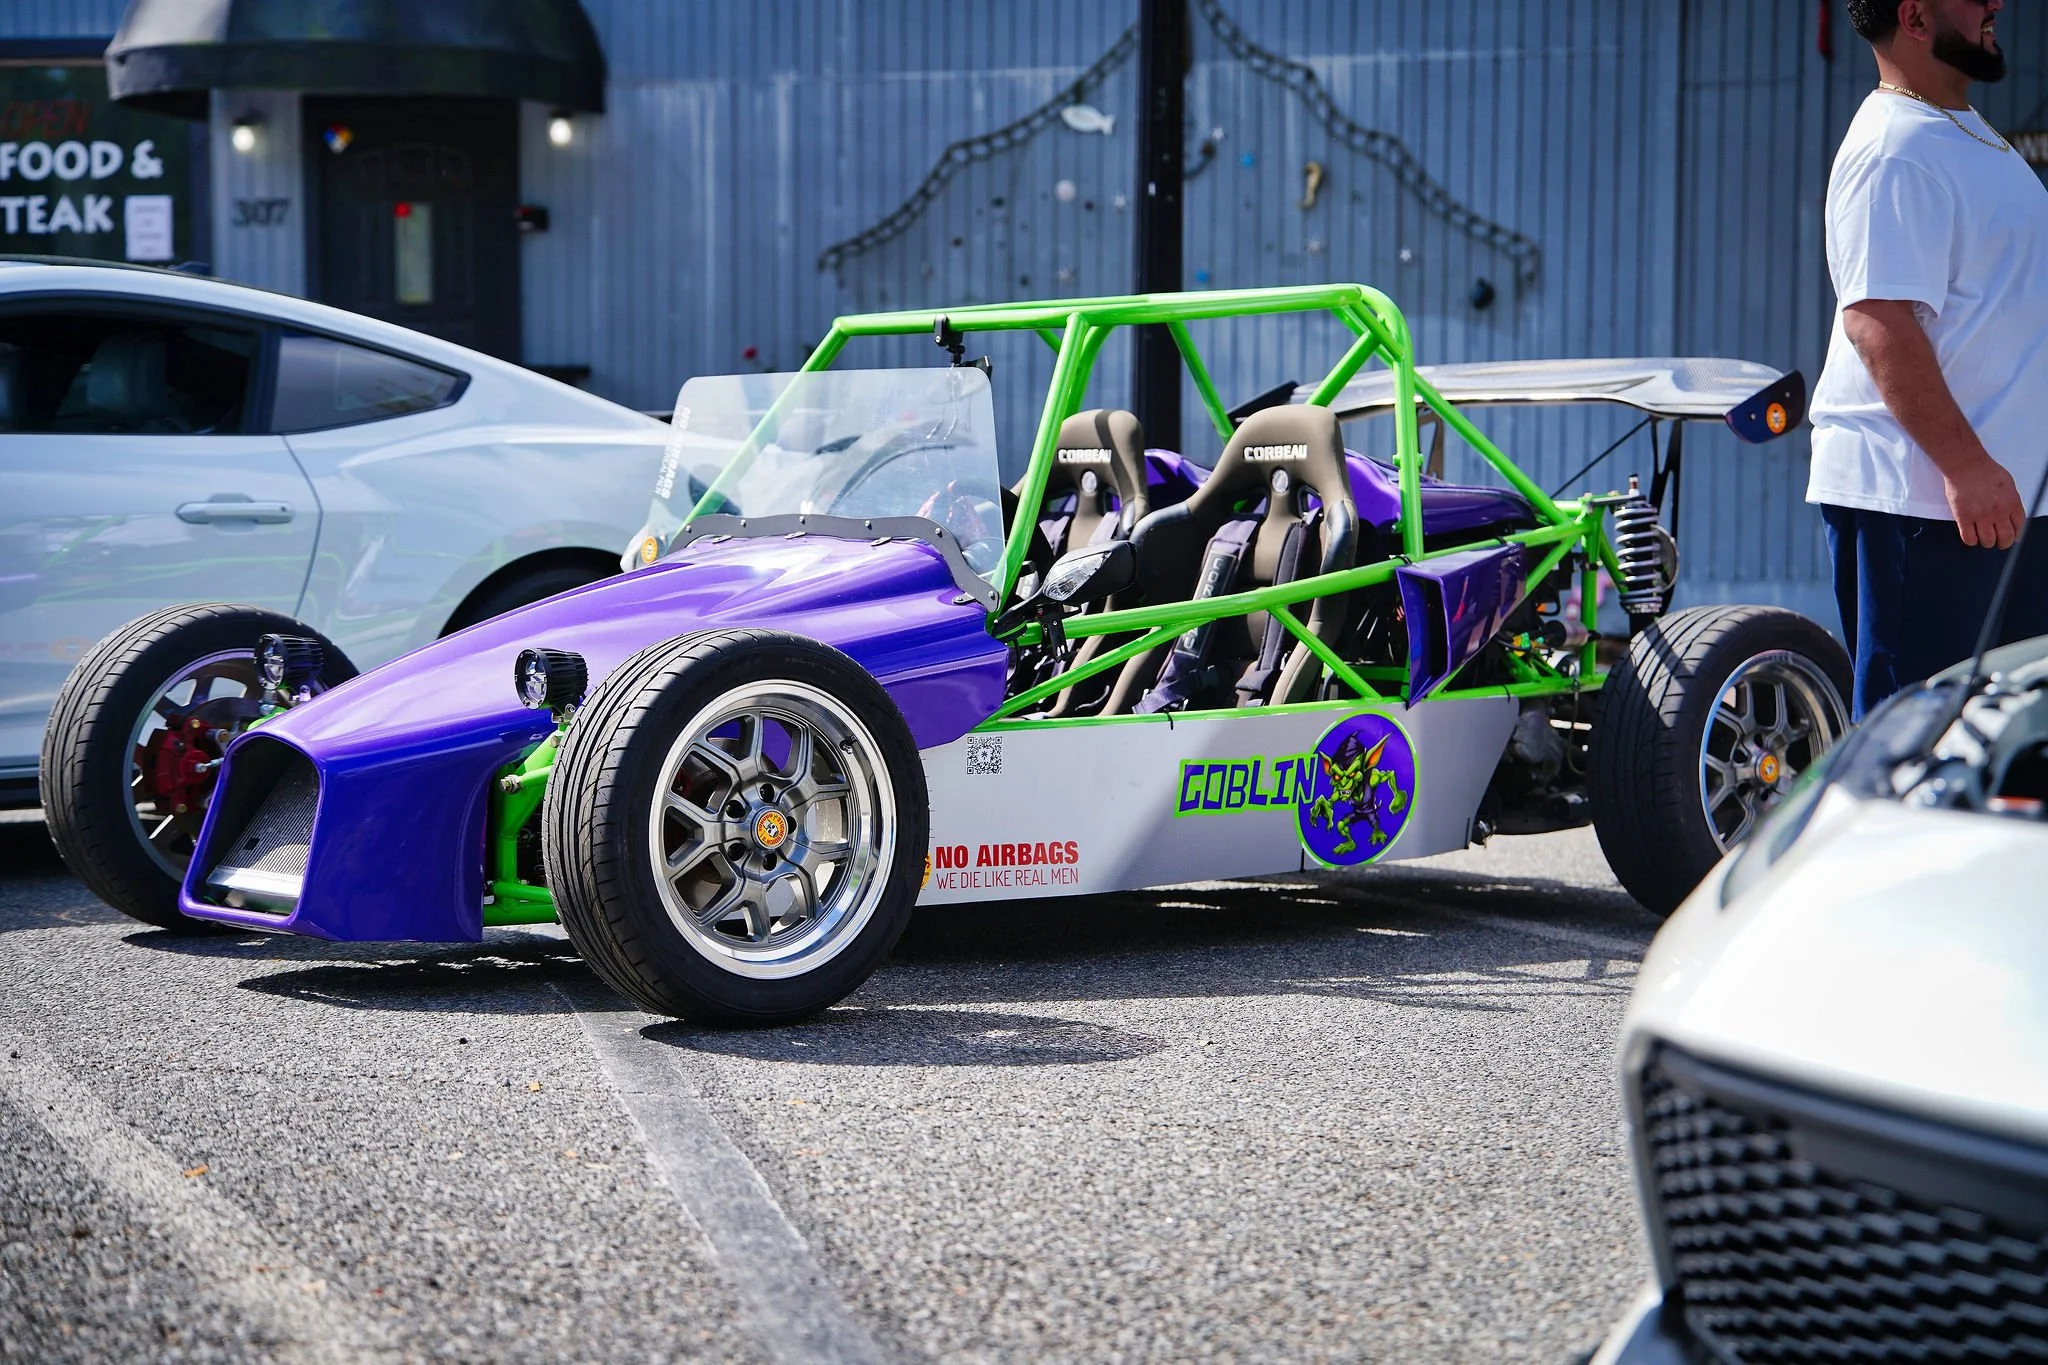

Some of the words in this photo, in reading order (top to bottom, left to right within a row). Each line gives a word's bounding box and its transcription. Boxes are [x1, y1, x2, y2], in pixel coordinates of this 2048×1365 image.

[131, 139, 163, 179] &
[1058, 449, 1112, 463] CORBEAU
[1244, 444, 1308, 462] CORBEAU
[1176, 755, 1318, 815] GOBLIN
[936, 845, 968, 868] NO
[976, 841, 1079, 867] AIRBAGS
[936, 872, 957, 889] WE
[961, 871, 981, 888] DIE
[985, 870, 1011, 887] LIKE
[1015, 868, 1048, 886] REAL
[1051, 867, 1079, 885] MEN
